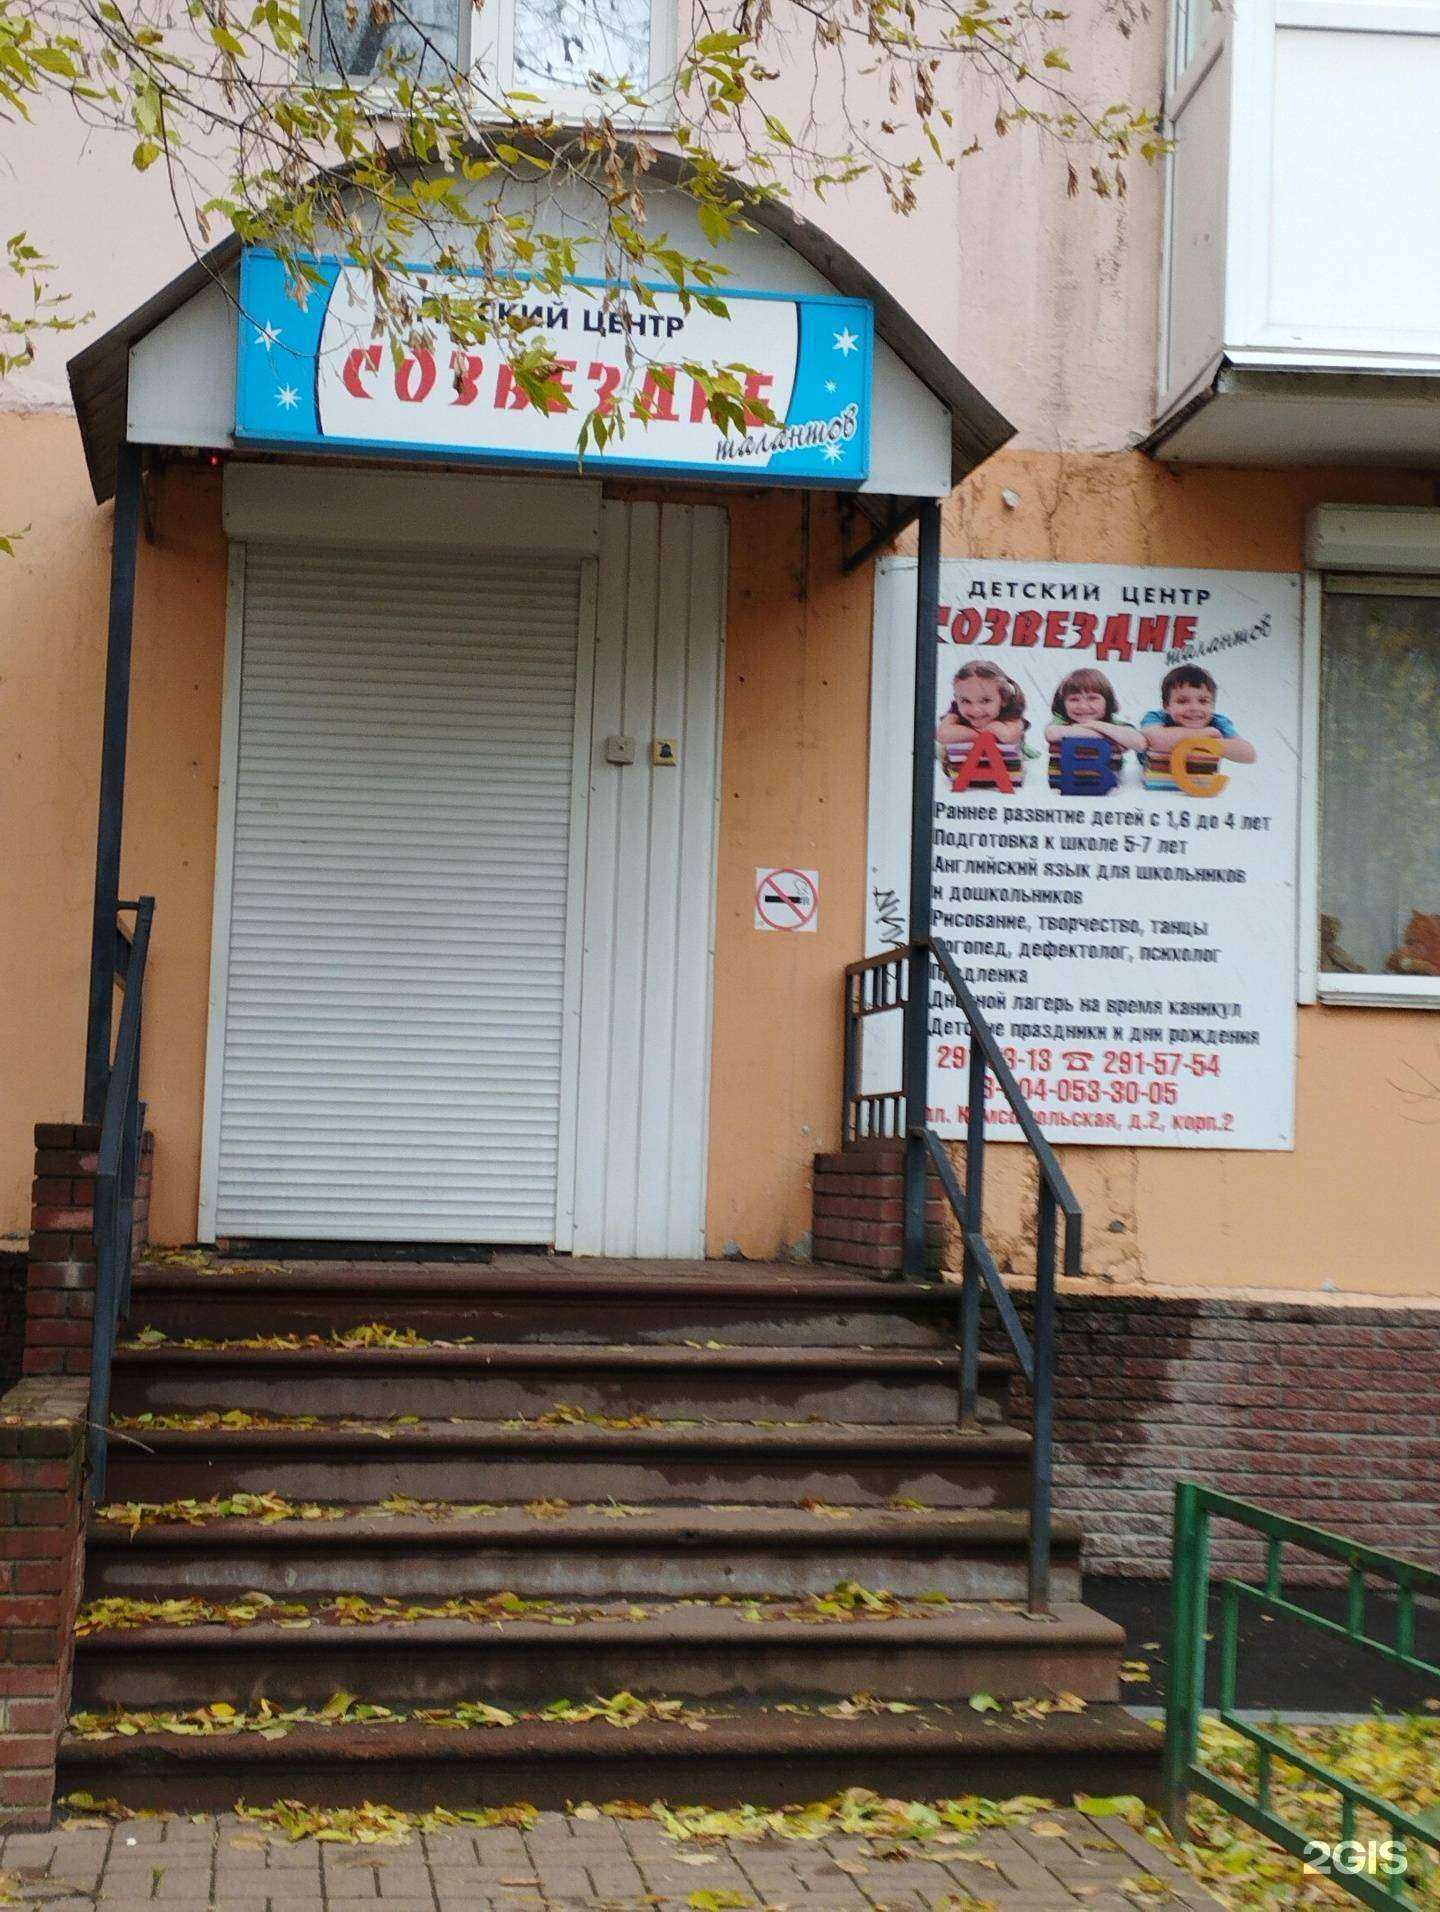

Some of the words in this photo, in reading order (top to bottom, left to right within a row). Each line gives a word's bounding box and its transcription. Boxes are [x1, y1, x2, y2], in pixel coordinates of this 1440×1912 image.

[583, 309, 684, 338] ЦЕНТР
[715, 402, 859, 461] талантов
[1122, 585, 1212, 607] ЦЕНТР
[935, 802, 998, 821] Раннее
[1004, 806, 1085, 825] развитие
[1091, 807, 1145, 827] детей
[1150, 812, 1160, 827] с
[1197, 813, 1219, 831] до
[1225, 812, 1236, 830] 4
[1241, 815, 1272, 832] лет
[934, 829, 1038, 849] Подготовка
[1045, 836, 1055, 849] к
[1061, 835, 1119, 853] школе
[1124, 835, 1152, 853] 5-7
[1157, 839, 1189, 855] лет
[933, 855, 1038, 877] Английский
[1043, 862, 1090, 879] язык
[1096, 864, 1130, 881] для
[1137, 865, 1247, 884] школьников
[949, 885, 1083, 904] дошкольников
[931, 909, 1031, 932] Рисование,
[1039, 914, 1144, 937] творчество,
[1151, 919, 1209, 937] танцы
[942, 939, 1012, 960] огопед,
[1018, 940, 1135, 963] дефектолог,
[1139, 945, 1222, 963] психолог
[1013, 995, 1074, 1014] лагерь
[1080, 998, 1100, 1013] на
[1105, 999, 1163, 1017] время
[1168, 1001, 1242, 1020] каникул
[1010, 1023, 1107, 1041] праздники
[1112, 1026, 1123, 1041] и
[1130, 1027, 1164, 1045] дни
[1168, 1028, 1260, 1046] рождения
[1103, 1049, 1222, 1078] 291-57-54
[1172, 1112, 1235, 1134] корп.2
